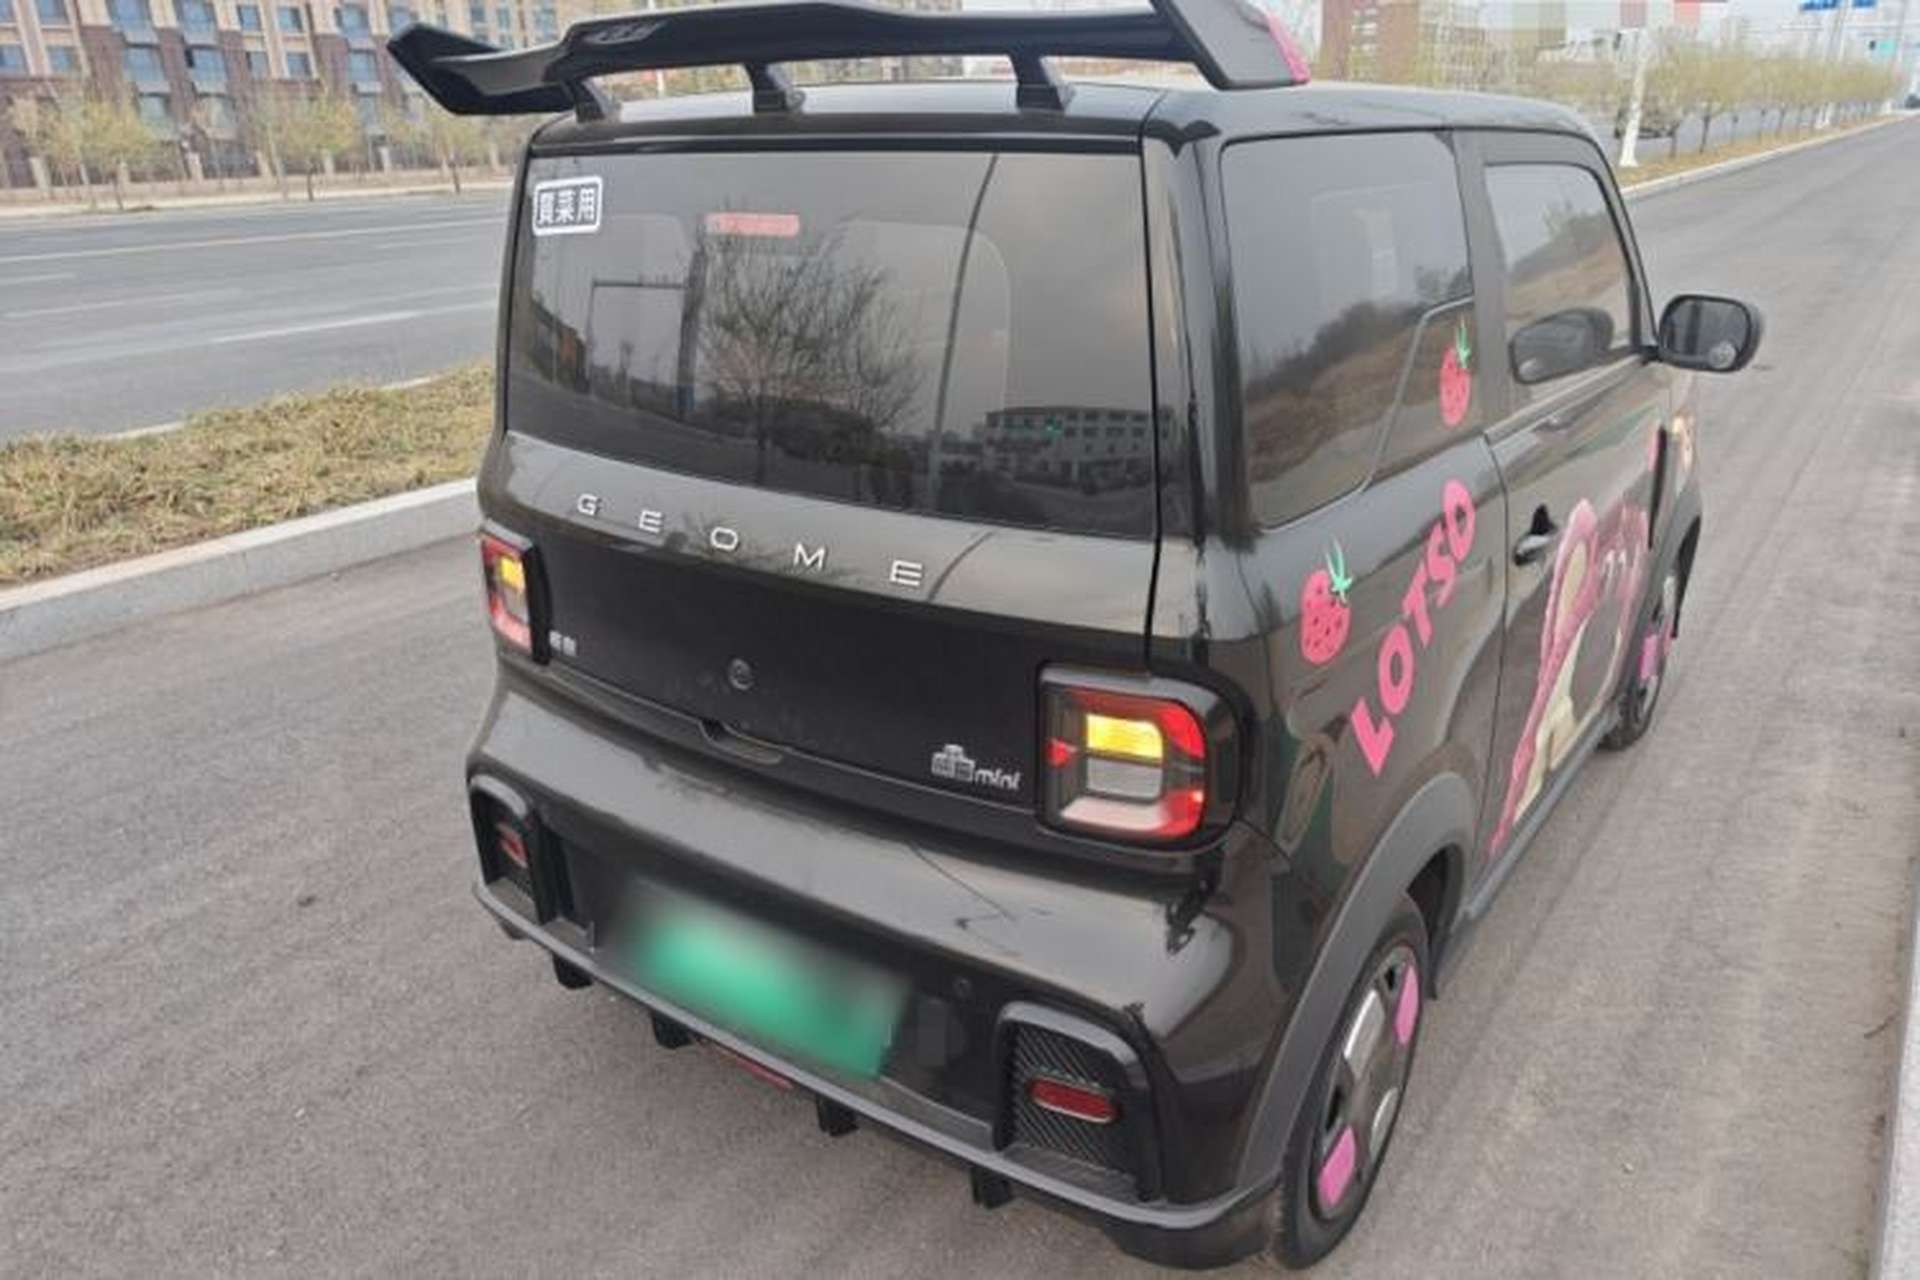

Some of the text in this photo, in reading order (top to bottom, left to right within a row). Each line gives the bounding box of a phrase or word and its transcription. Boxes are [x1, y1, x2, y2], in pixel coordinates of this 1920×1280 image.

[577, 493, 923, 587] GEOME
[1352, 480, 1475, 776] LOTSO
[975, 767, 1021, 790] mini
